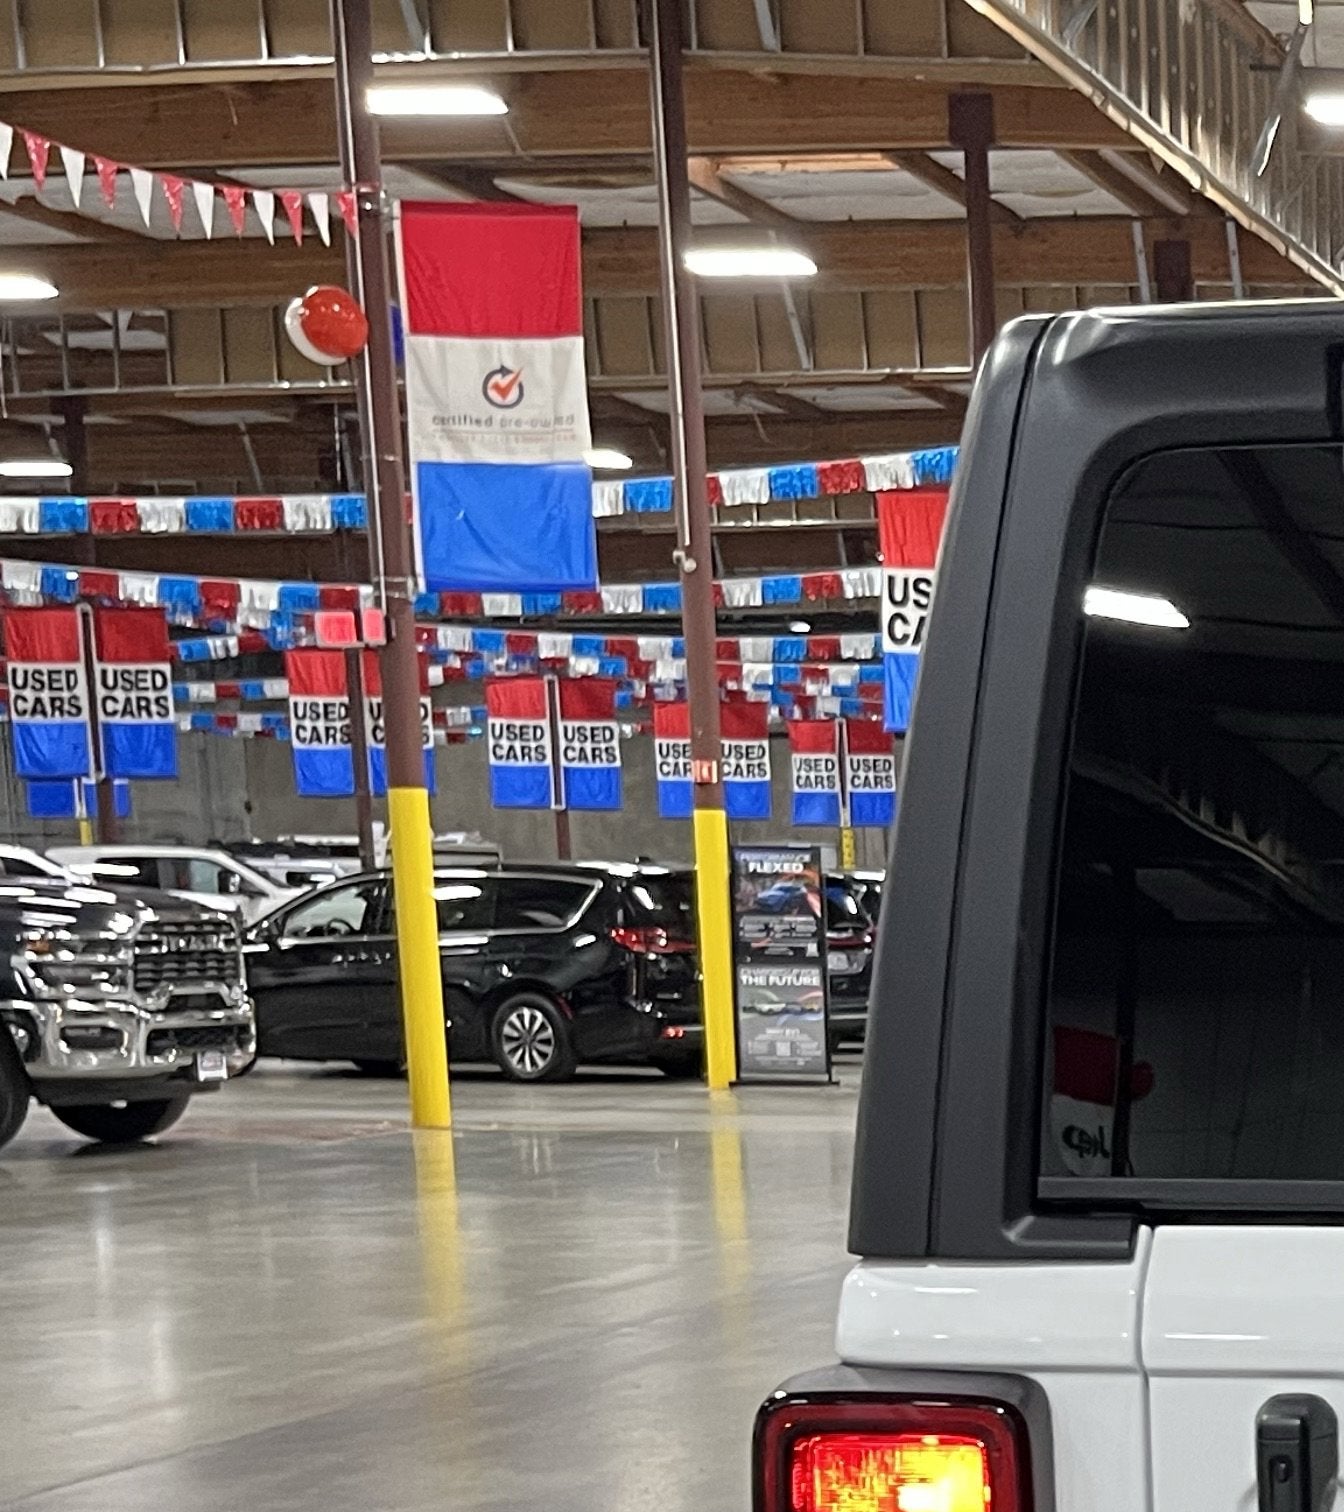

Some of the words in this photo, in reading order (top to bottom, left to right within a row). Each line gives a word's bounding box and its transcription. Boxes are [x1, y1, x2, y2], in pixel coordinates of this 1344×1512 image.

[888, 574, 933, 611] US
[11, 667, 79, 692] USED
[100, 668, 168, 692] USED
[13, 695, 83, 719] CARS
[101, 695, 170, 719] CARS
[293, 702, 350, 722] USED
[295, 724, 351, 745] CARS
[491, 723, 545, 742] USED
[563, 724, 615, 744] USED
[492, 743, 547, 762] CARS
[563, 745, 617, 764] CARS
[658, 743, 692, 760] USE
[721, 743, 766, 761] USED
[659, 761, 692, 777] CAR
[722, 761, 767, 778] CARS
[794, 758, 836, 773] USED
[850, 758, 892, 774] USED
[796, 774, 836, 790] CARS
[851, 774, 894, 790] CARS
[748, 861, 805, 874] FLEXED
[741, 975, 767, 986] THE
[769, 975, 821, 987] FUTURE
